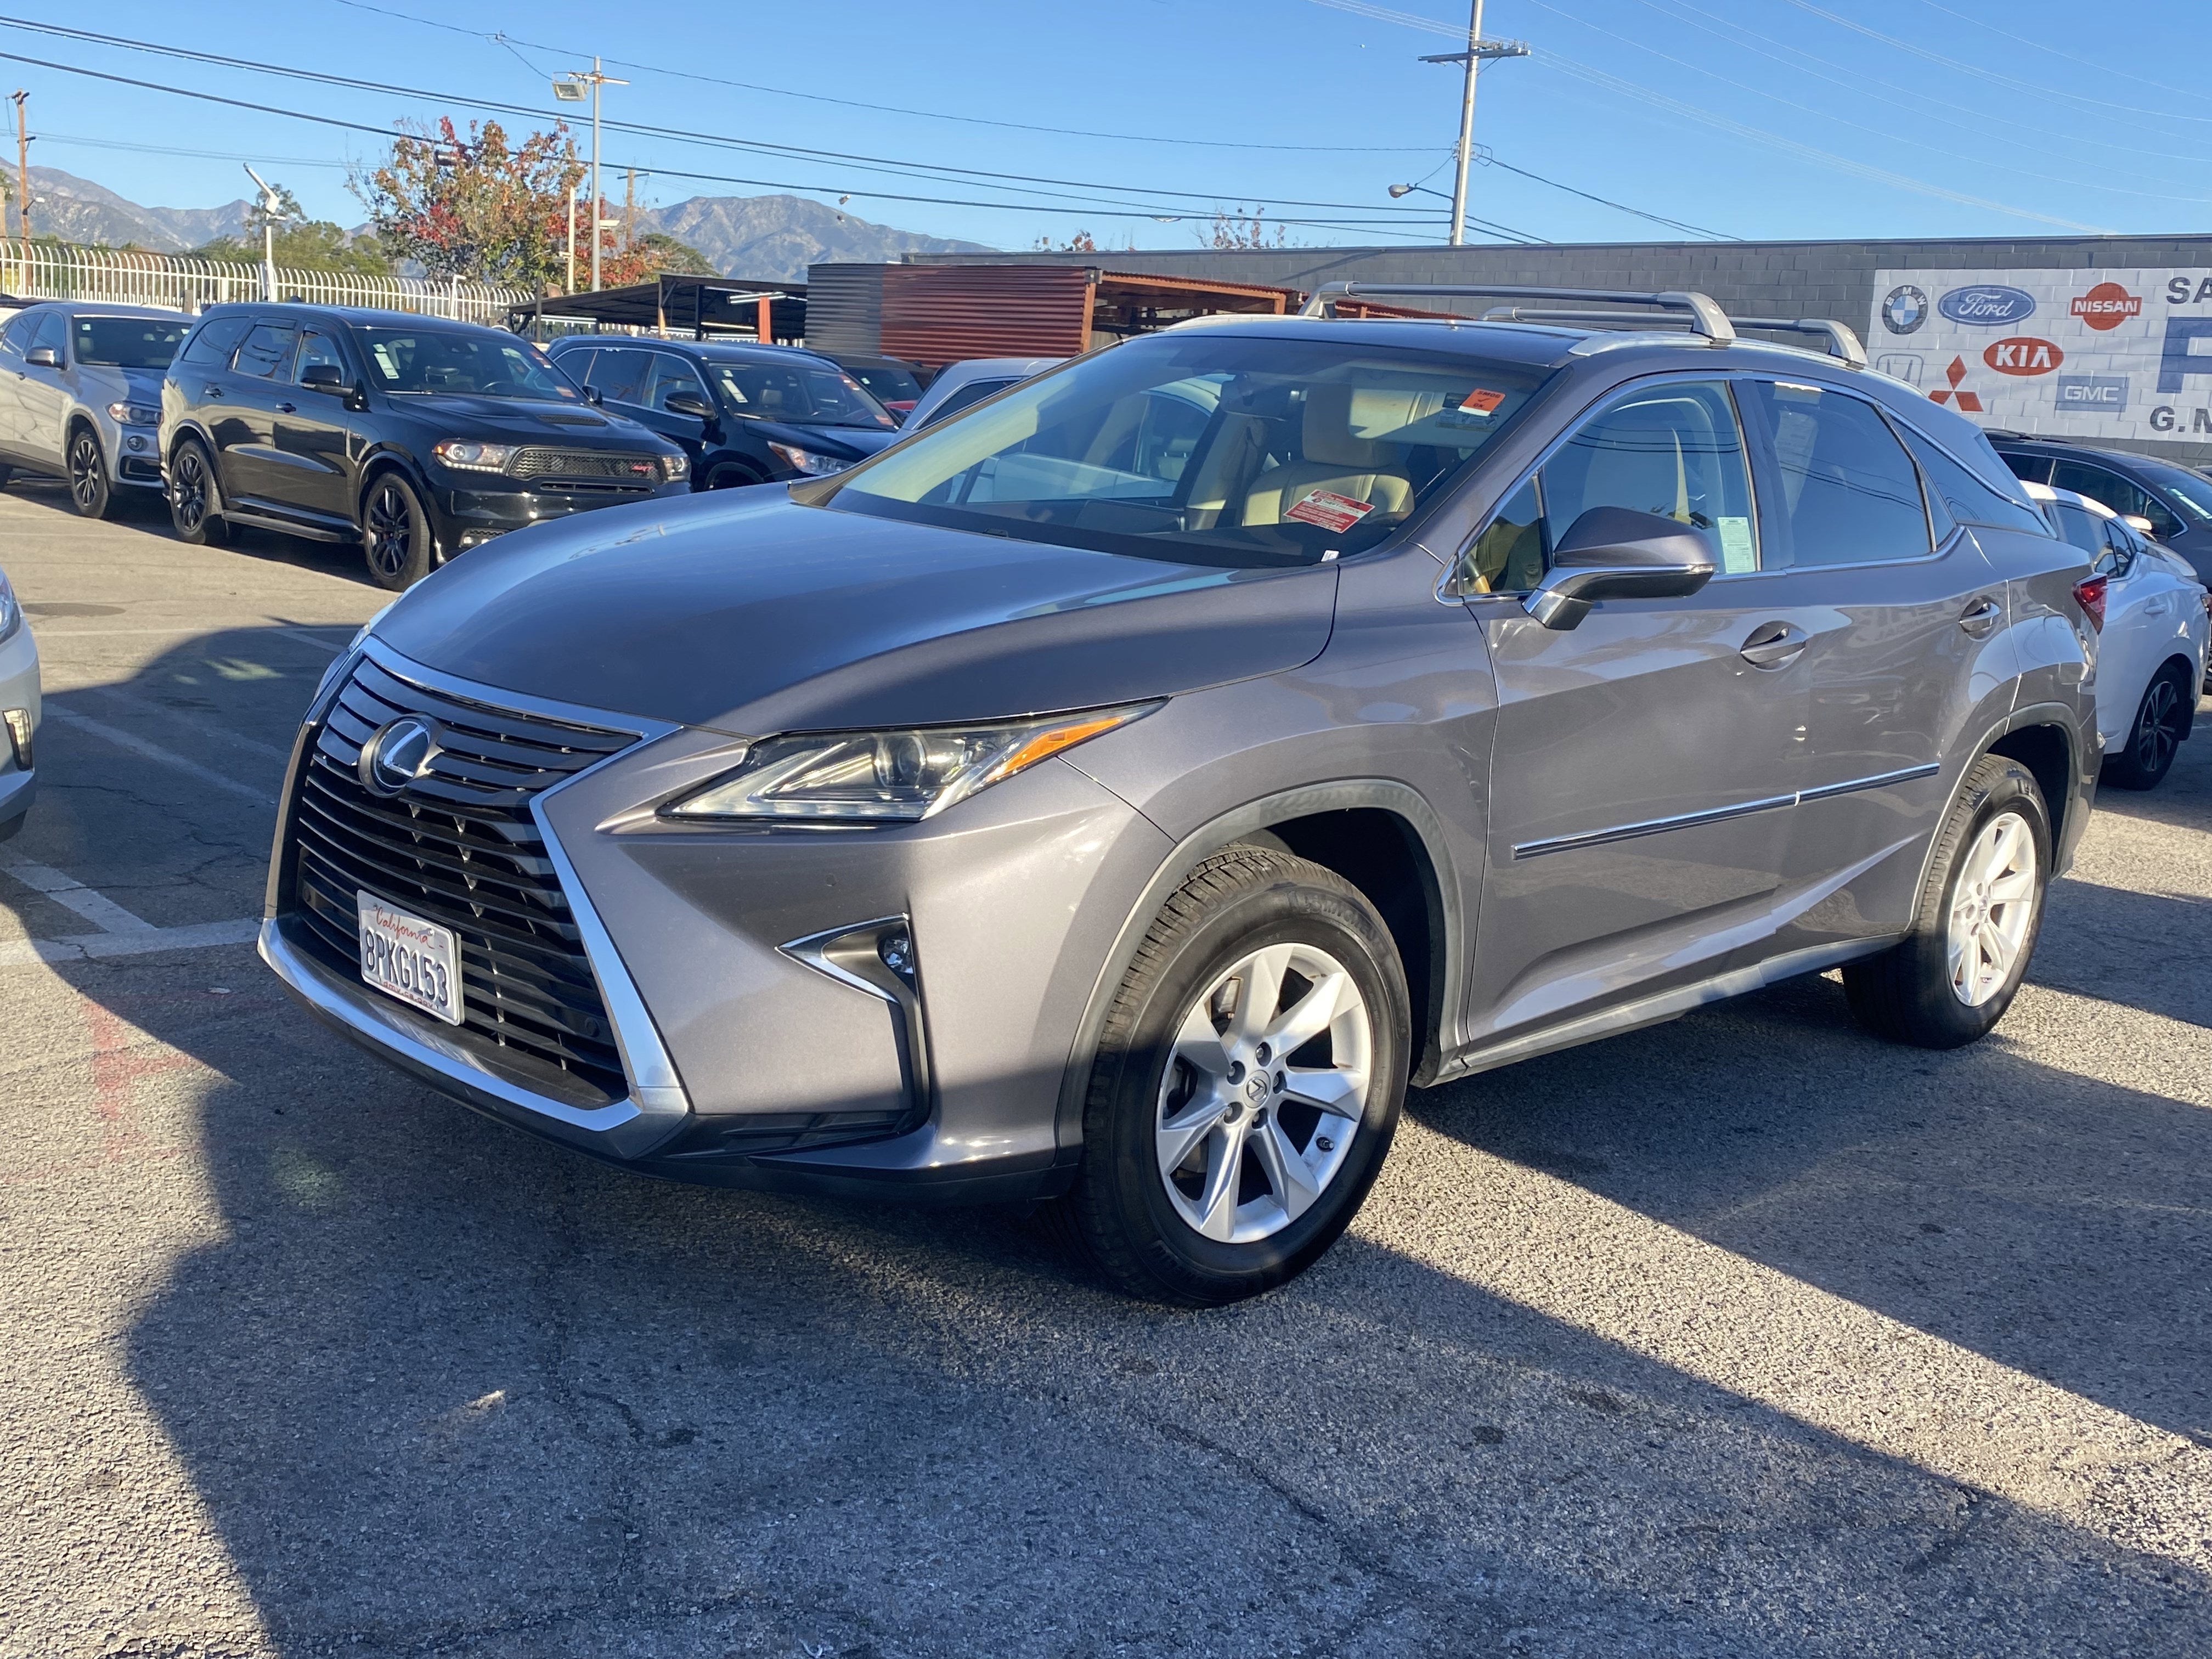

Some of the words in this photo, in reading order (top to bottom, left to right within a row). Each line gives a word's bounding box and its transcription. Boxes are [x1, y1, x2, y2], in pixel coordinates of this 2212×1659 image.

[1886, 286, 1928, 307] BMW
[1957, 292, 2015, 317] Ford
[2074, 300, 2137, 313] NISSAN
[1996, 344, 2051, 368] KIA
[2064, 385, 2119, 402] GMC
[376, 906, 435, 949] California
[365, 929, 448, 1007] 8PKG153
[383, 980, 433, 1009] dmv.ca.gov
